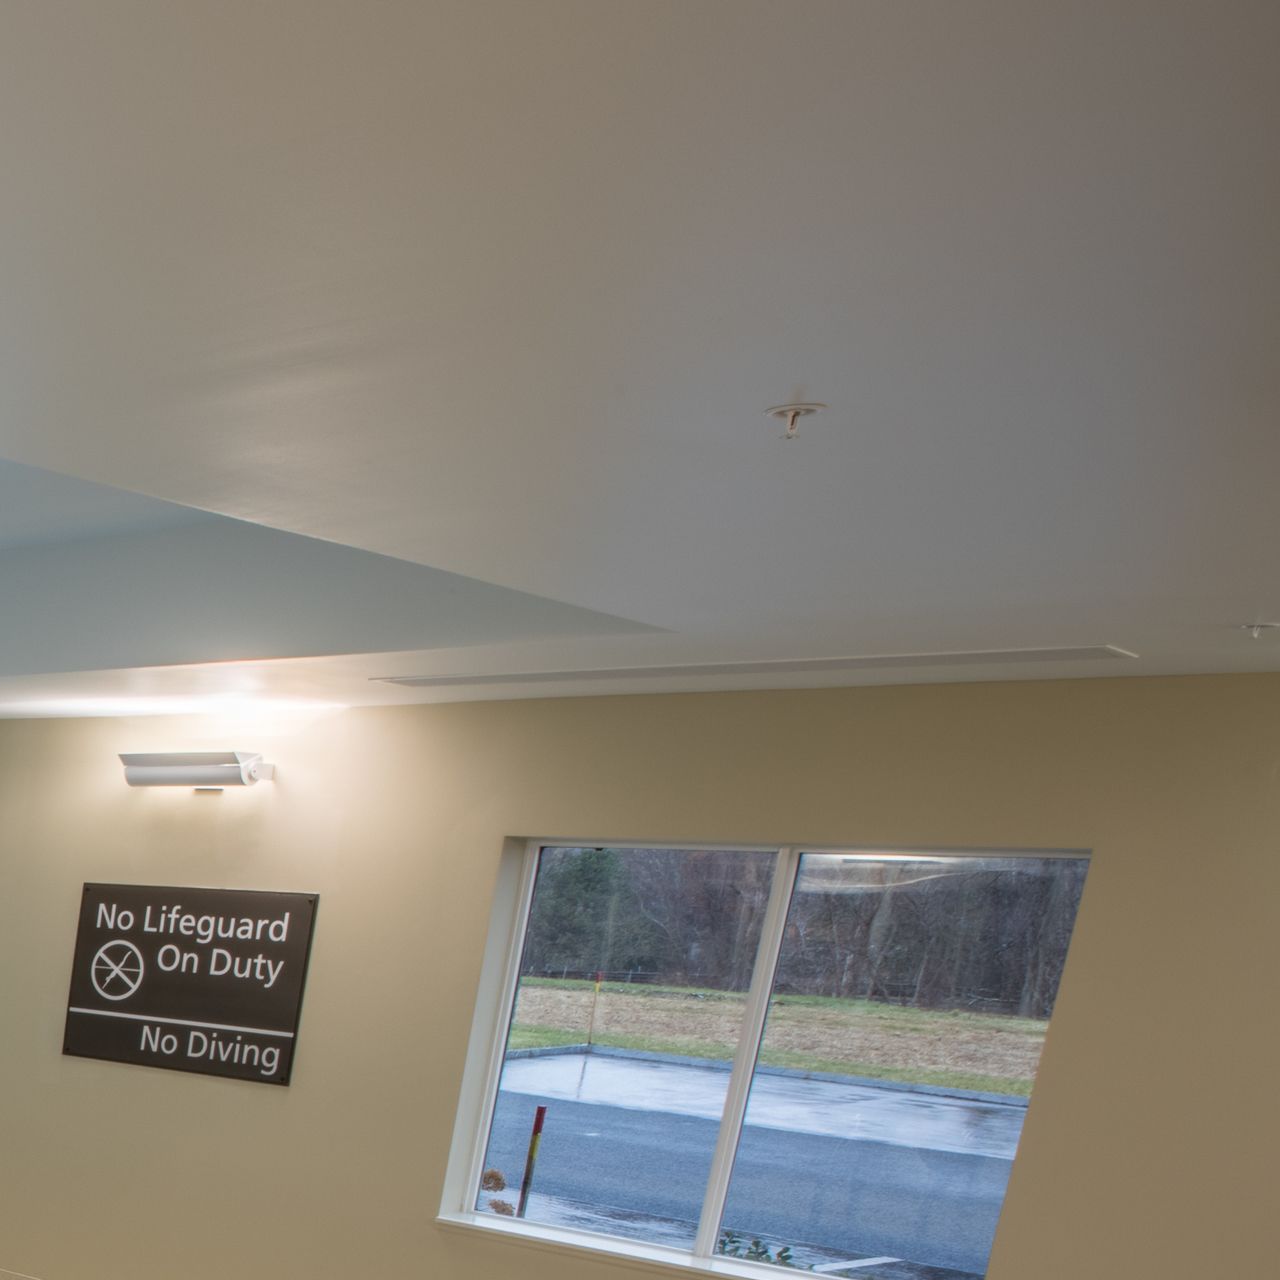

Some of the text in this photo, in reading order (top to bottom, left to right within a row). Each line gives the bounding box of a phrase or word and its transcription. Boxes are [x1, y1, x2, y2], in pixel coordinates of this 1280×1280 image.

[96, 903, 290, 944] No Lifeguard
[157, 944, 284, 988] On Duty
[140, 1025, 280, 1075] No Diving
